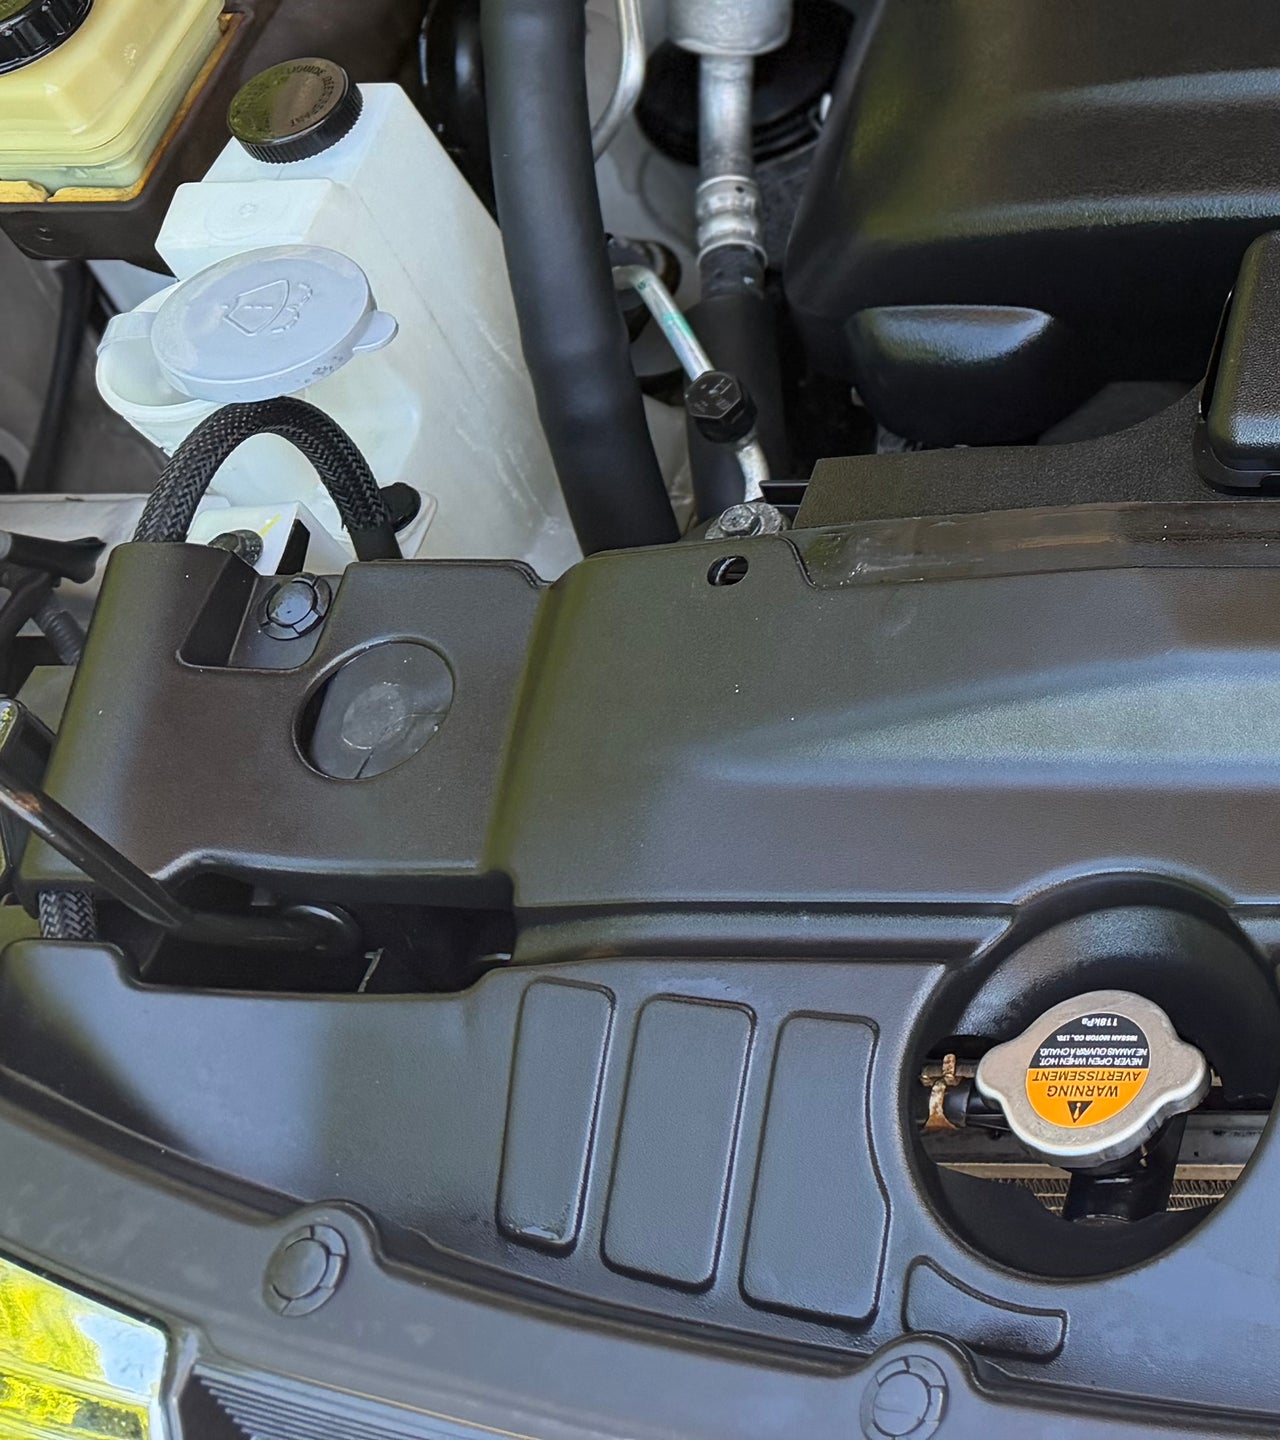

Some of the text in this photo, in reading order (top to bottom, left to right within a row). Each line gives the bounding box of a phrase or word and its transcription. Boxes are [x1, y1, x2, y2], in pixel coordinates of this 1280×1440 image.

[1082, 1017, 1118, 1026] 118kPa
[1108, 1048, 1137, 1056] JAMAIS
[1138, 1048, 1148, 1056] NE
[1039, 1056, 1143, 1065] NEVER OPEN WHEN HOT.
[1032, 1071, 1141, 1081] AVERTISSEMENT
[1047, 1085, 1119, 1097] WARNING
